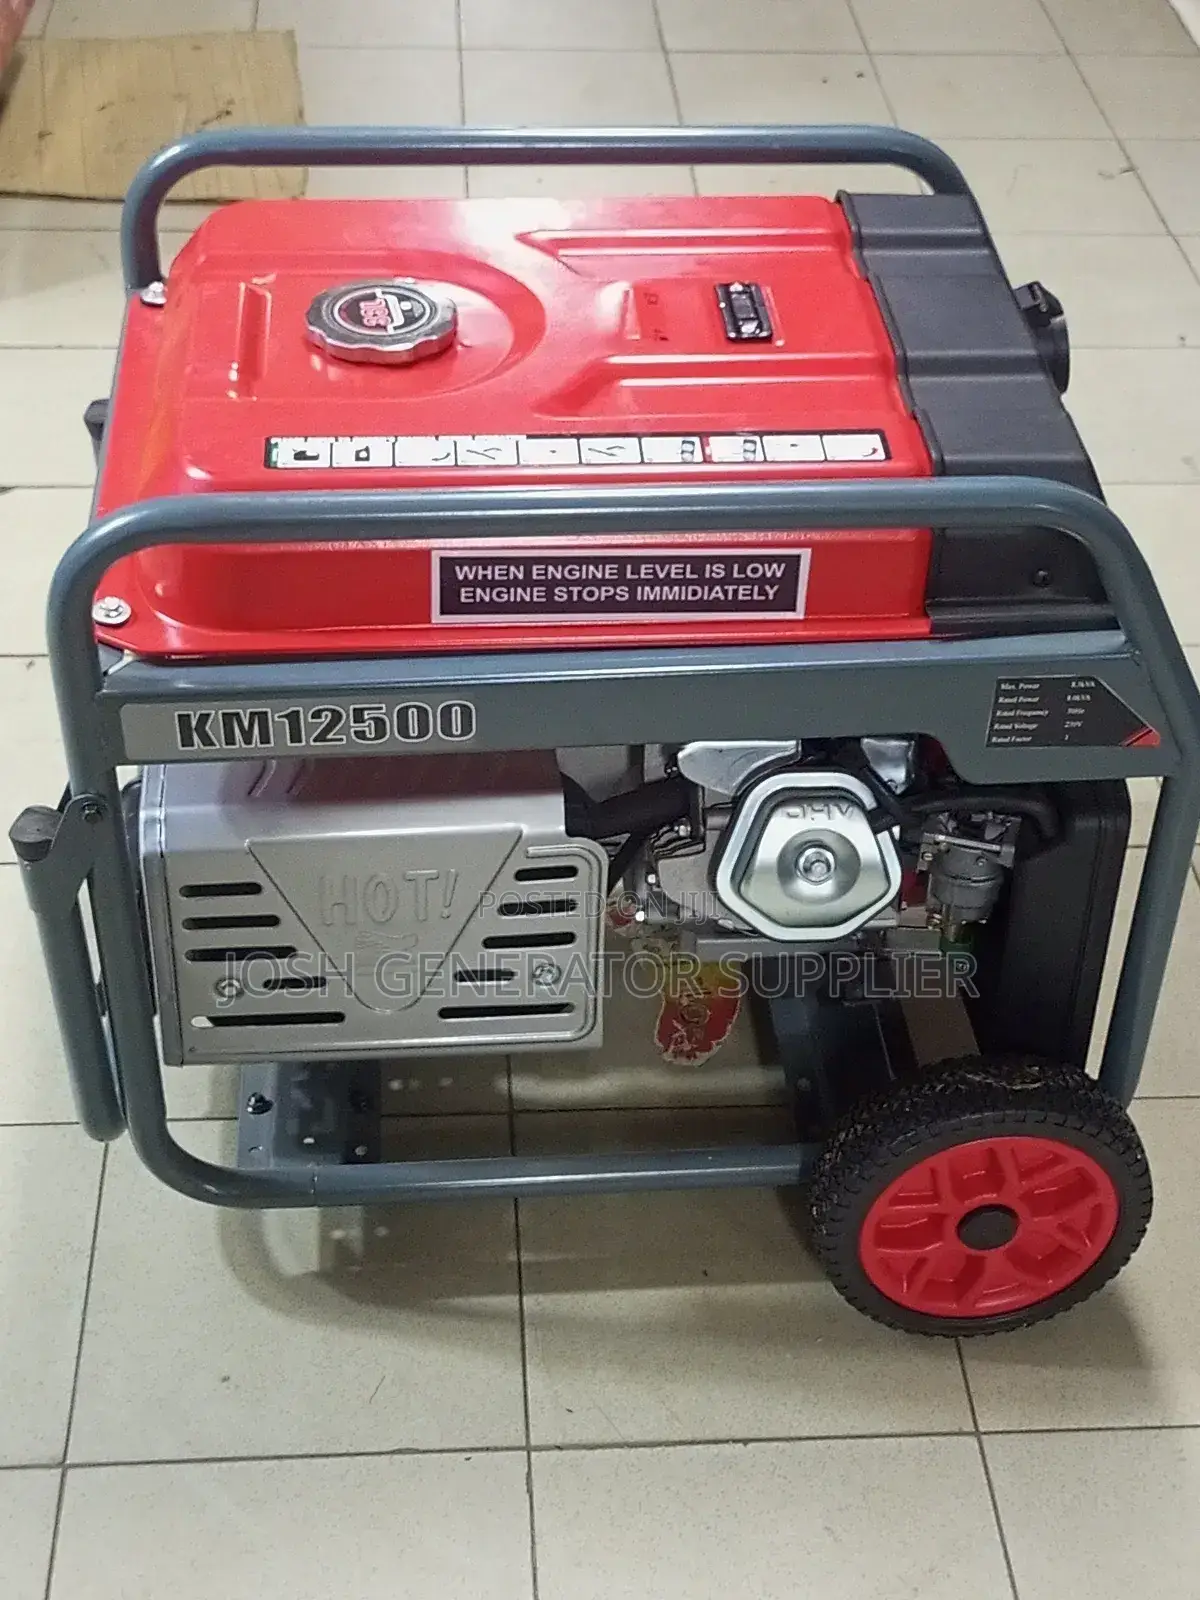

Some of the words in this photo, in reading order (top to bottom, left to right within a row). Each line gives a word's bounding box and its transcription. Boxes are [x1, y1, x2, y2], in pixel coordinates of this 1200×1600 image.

[454, 564, 525, 581] WHEN
[532, 563, 620, 580] ENGINE
[626, 563, 699, 580] LEVEL
[704, 563, 727, 579] IS
[733, 562, 787, 579] LOW
[460, 586, 547, 603] ENGINE
[553, 585, 630, 602] STOPS
[636, 584, 780, 602] IMMIDIATELY
[1018, 682, 1040, 690] Power
[996, 709, 1015, 717] Rated
[1015, 709, 1049, 718] Frequency
[175, 700, 477, 750] KM12500
[993, 722, 1013, 730] Rated
[1014, 722, 1039, 730] Voltage
[318, 867, 459, 927] HOT!
